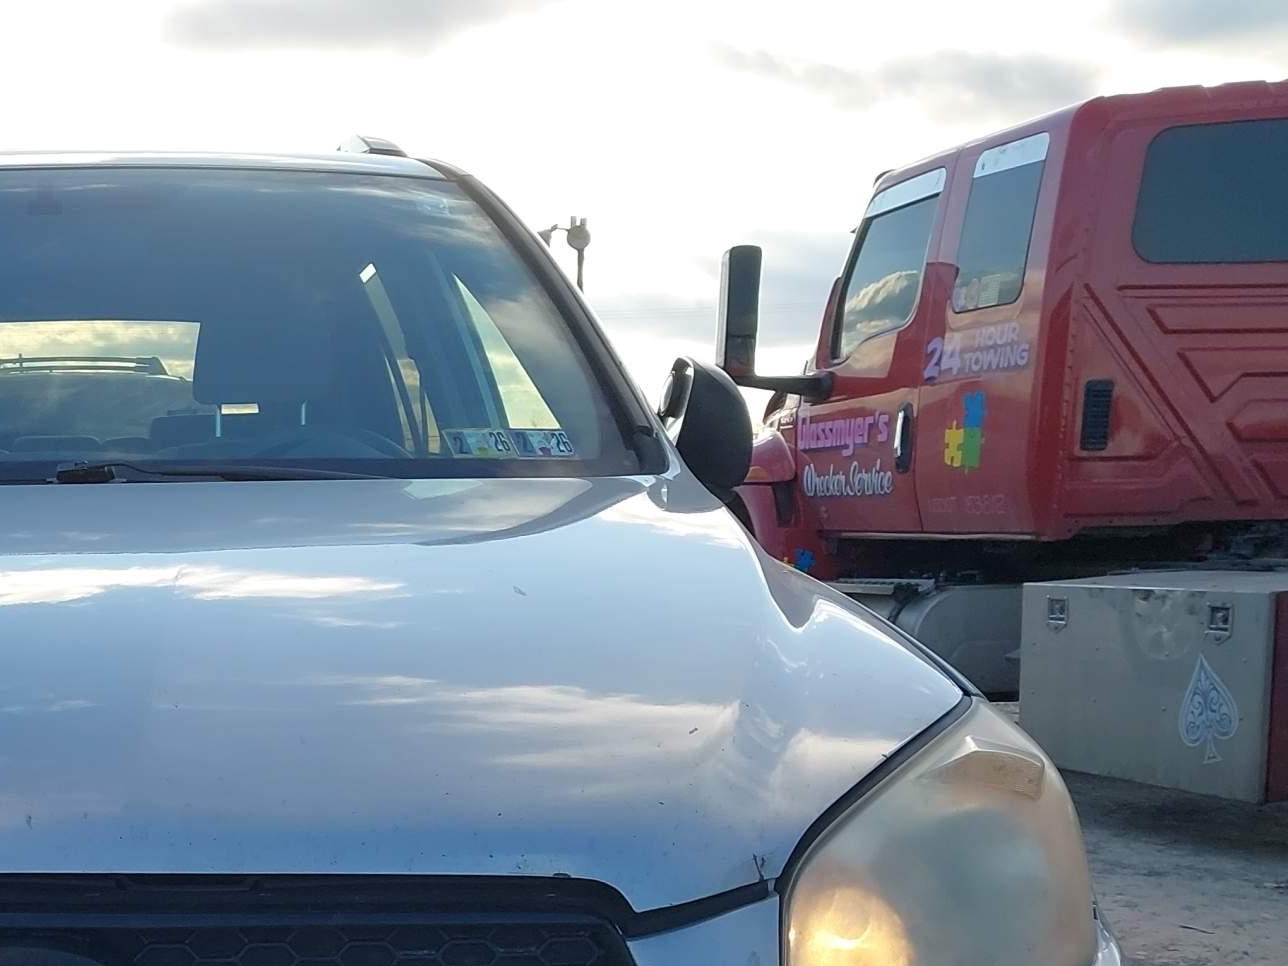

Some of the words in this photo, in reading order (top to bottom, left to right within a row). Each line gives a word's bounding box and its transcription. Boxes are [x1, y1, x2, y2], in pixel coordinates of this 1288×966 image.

[975, 321, 1019, 348] HOUR
[923, 334, 961, 383] 24
[964, 344, 1029, 373] TOWING
[489, 431, 511, 452] 26
[551, 432, 574, 453] 26
[847, 458, 893, 496] Service
